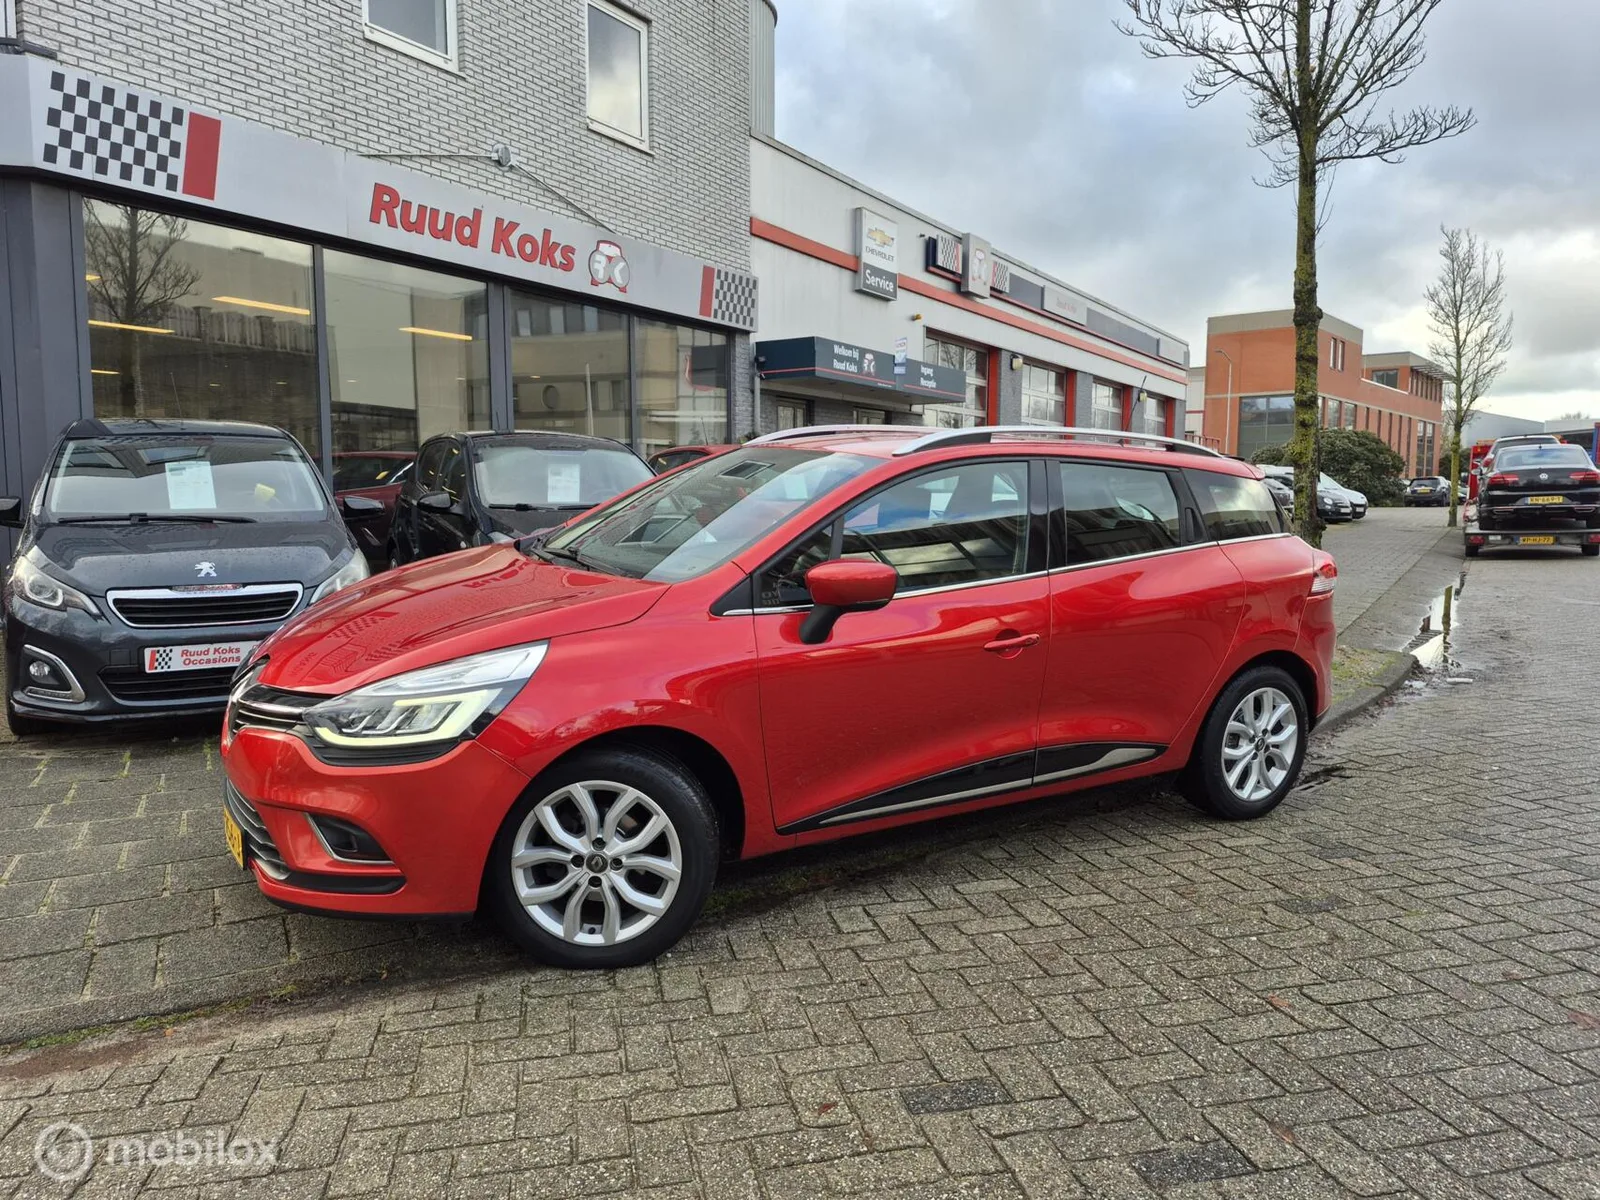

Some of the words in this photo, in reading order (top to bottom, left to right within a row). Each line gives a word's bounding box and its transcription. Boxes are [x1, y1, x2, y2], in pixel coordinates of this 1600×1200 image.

[369, 182, 483, 249] Ruud
[491, 216, 576, 273] Koks
[865, 246, 894, 262] CHEVROLET
[865, 269, 894, 292] Service
[833, 344, 853, 358] Welkom
[833, 359, 846, 371] Ruud
[845, 361, 858, 373] Koks
[920, 364, 934, 377] Ingang
[181, 648, 210, 657] Ruud
[213, 646, 241, 655] Koks
[182, 655, 241, 666] Occasions
